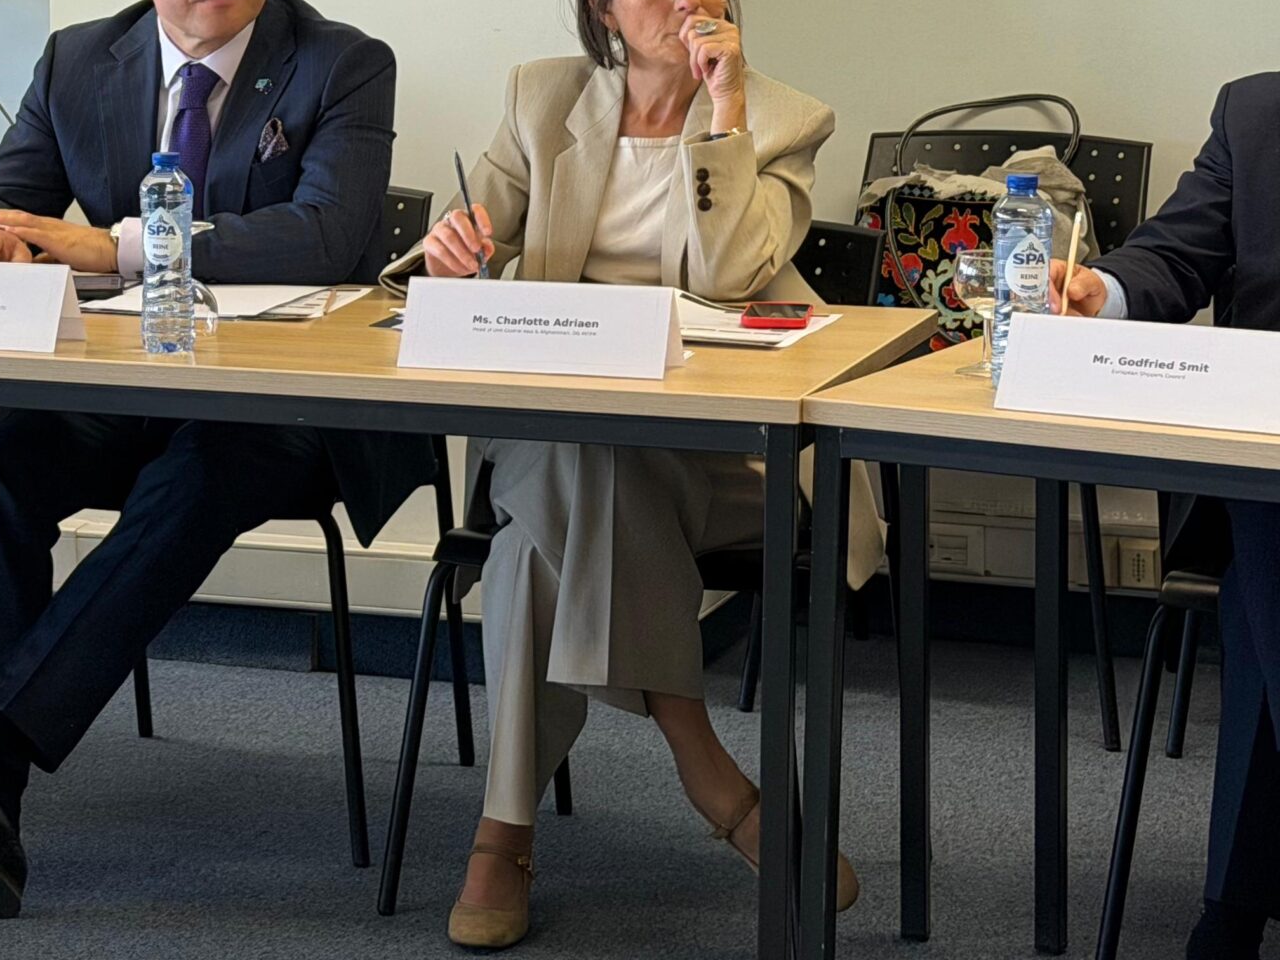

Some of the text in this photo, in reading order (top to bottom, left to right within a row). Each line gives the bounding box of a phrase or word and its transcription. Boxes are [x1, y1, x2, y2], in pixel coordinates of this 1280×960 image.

[147, 224, 177, 236] SPA
[1012, 252, 1046, 265] SPA
[472, 315, 600, 328] Ms. Charlotte Adriaen
[1092, 354, 1210, 373] Mr. Godfried Smit
